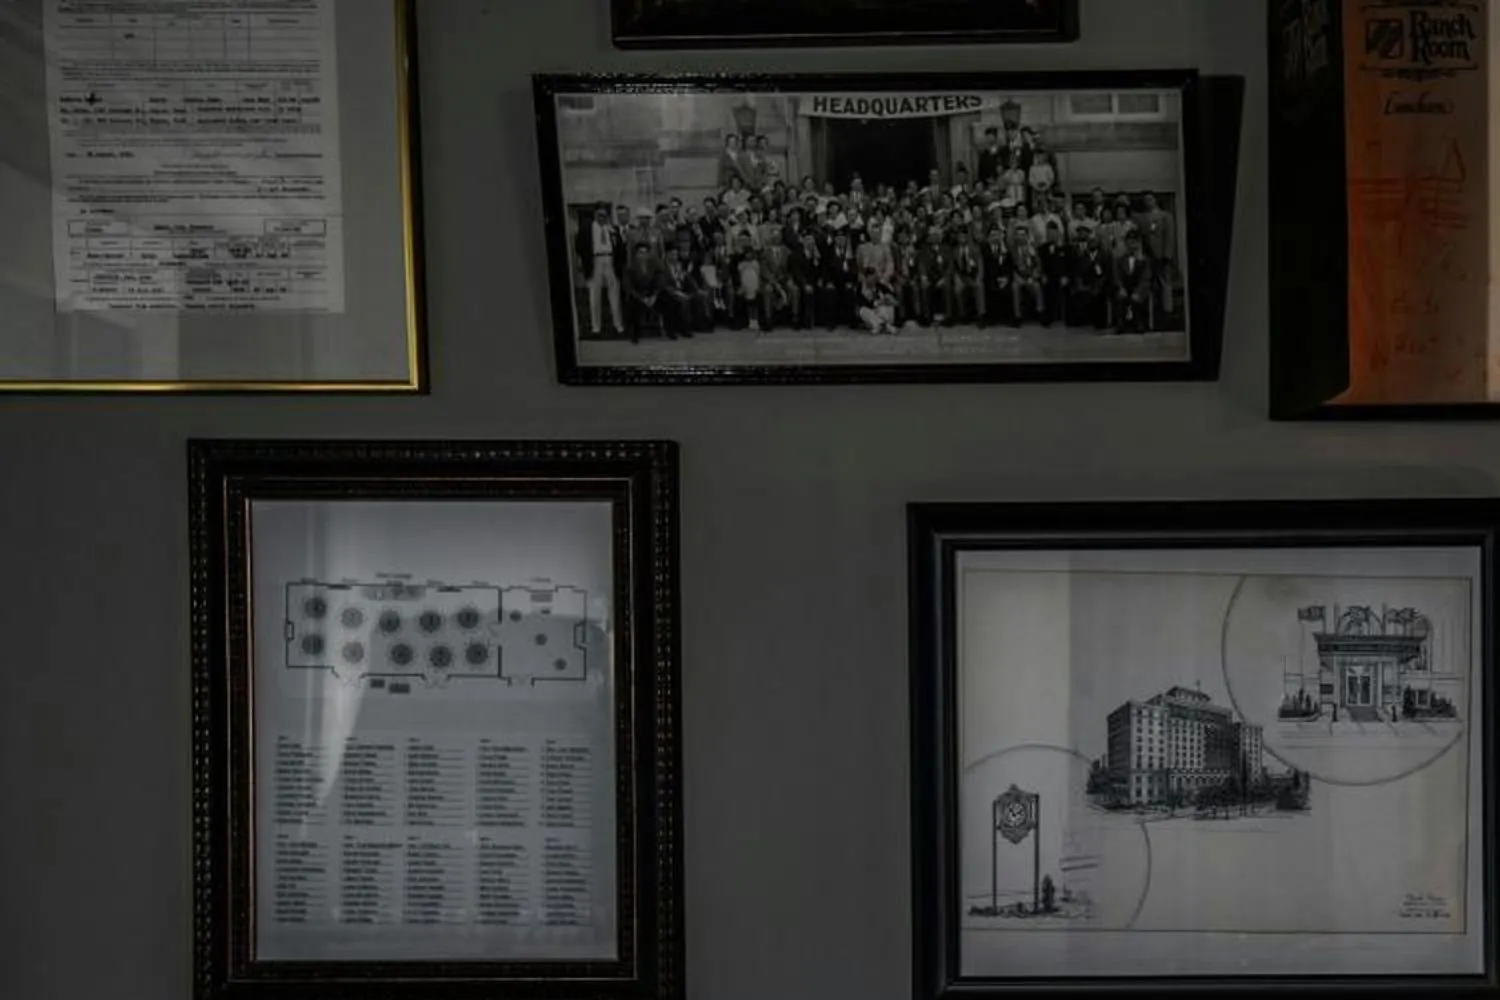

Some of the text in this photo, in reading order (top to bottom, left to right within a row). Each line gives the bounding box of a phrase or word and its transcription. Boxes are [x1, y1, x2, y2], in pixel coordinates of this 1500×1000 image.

[1408, 11, 1476, 39] Ranch
[1411, 35, 1471, 64] Room
[814, 96, 982, 116] HEADQUARTERS
